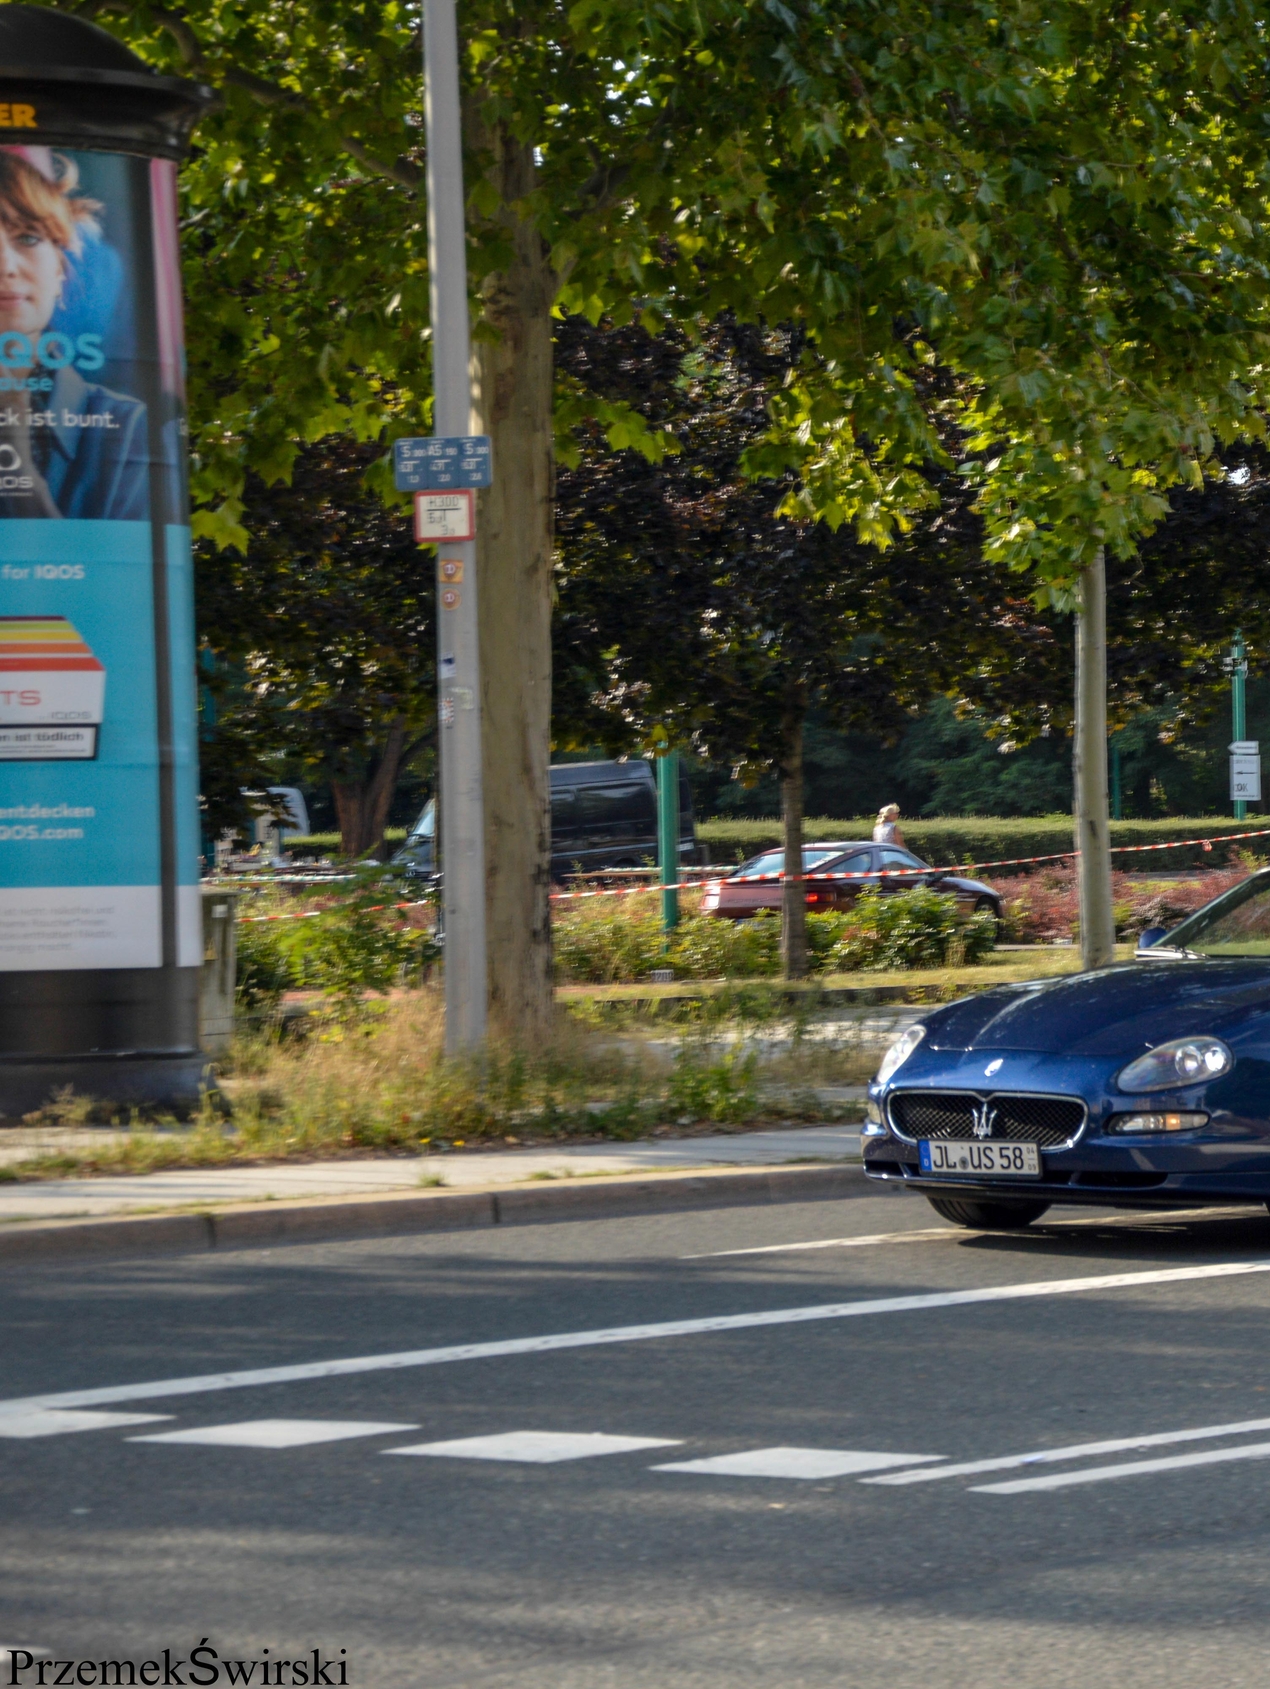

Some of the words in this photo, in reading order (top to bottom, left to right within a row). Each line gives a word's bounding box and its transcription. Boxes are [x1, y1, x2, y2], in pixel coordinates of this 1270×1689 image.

[27, 408, 57, 427] ist
[63, 408, 120, 429] bunt.
[0, 476, 34, 489] OS
[2, 564, 30, 579] for
[34, 564, 85, 579] IQOS
[933, 1145, 957, 1169] JL
[969, 1145, 995, 1170] US
[998, 1146, 1025, 1170] 58
